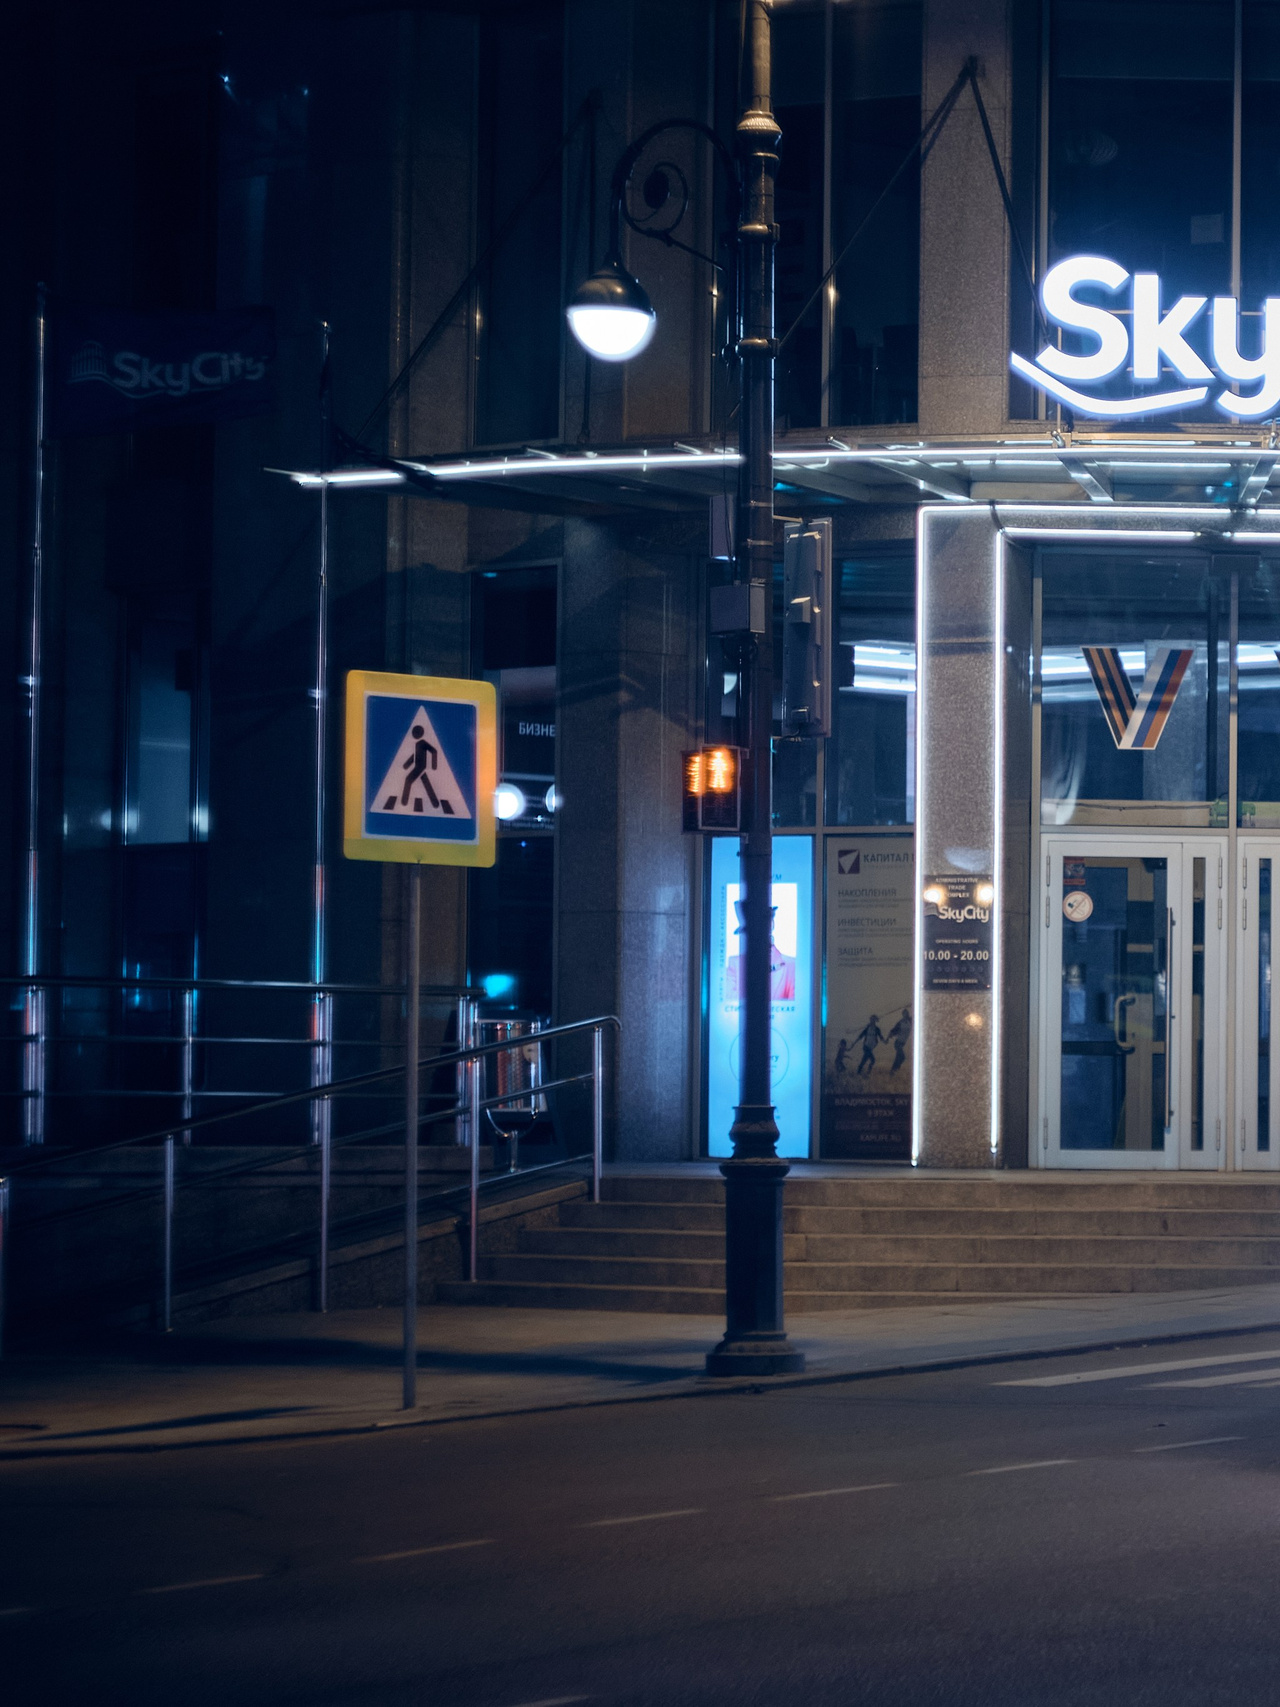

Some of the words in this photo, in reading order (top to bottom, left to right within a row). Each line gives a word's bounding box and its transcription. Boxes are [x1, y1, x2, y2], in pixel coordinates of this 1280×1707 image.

[863, 853, 909, 864] КАПИТАЛ
[838, 888, 898, 898] НАКОПЛЕНИЯ
[938, 905, 989, 923] SkyCity
[838, 917, 898, 928] ИНВЕСТИЦИИ
[838, 947, 874, 957] ЗАЩИТА
[924, 949, 951, 961] 10.00
[960, 949, 989, 961] 20.00
